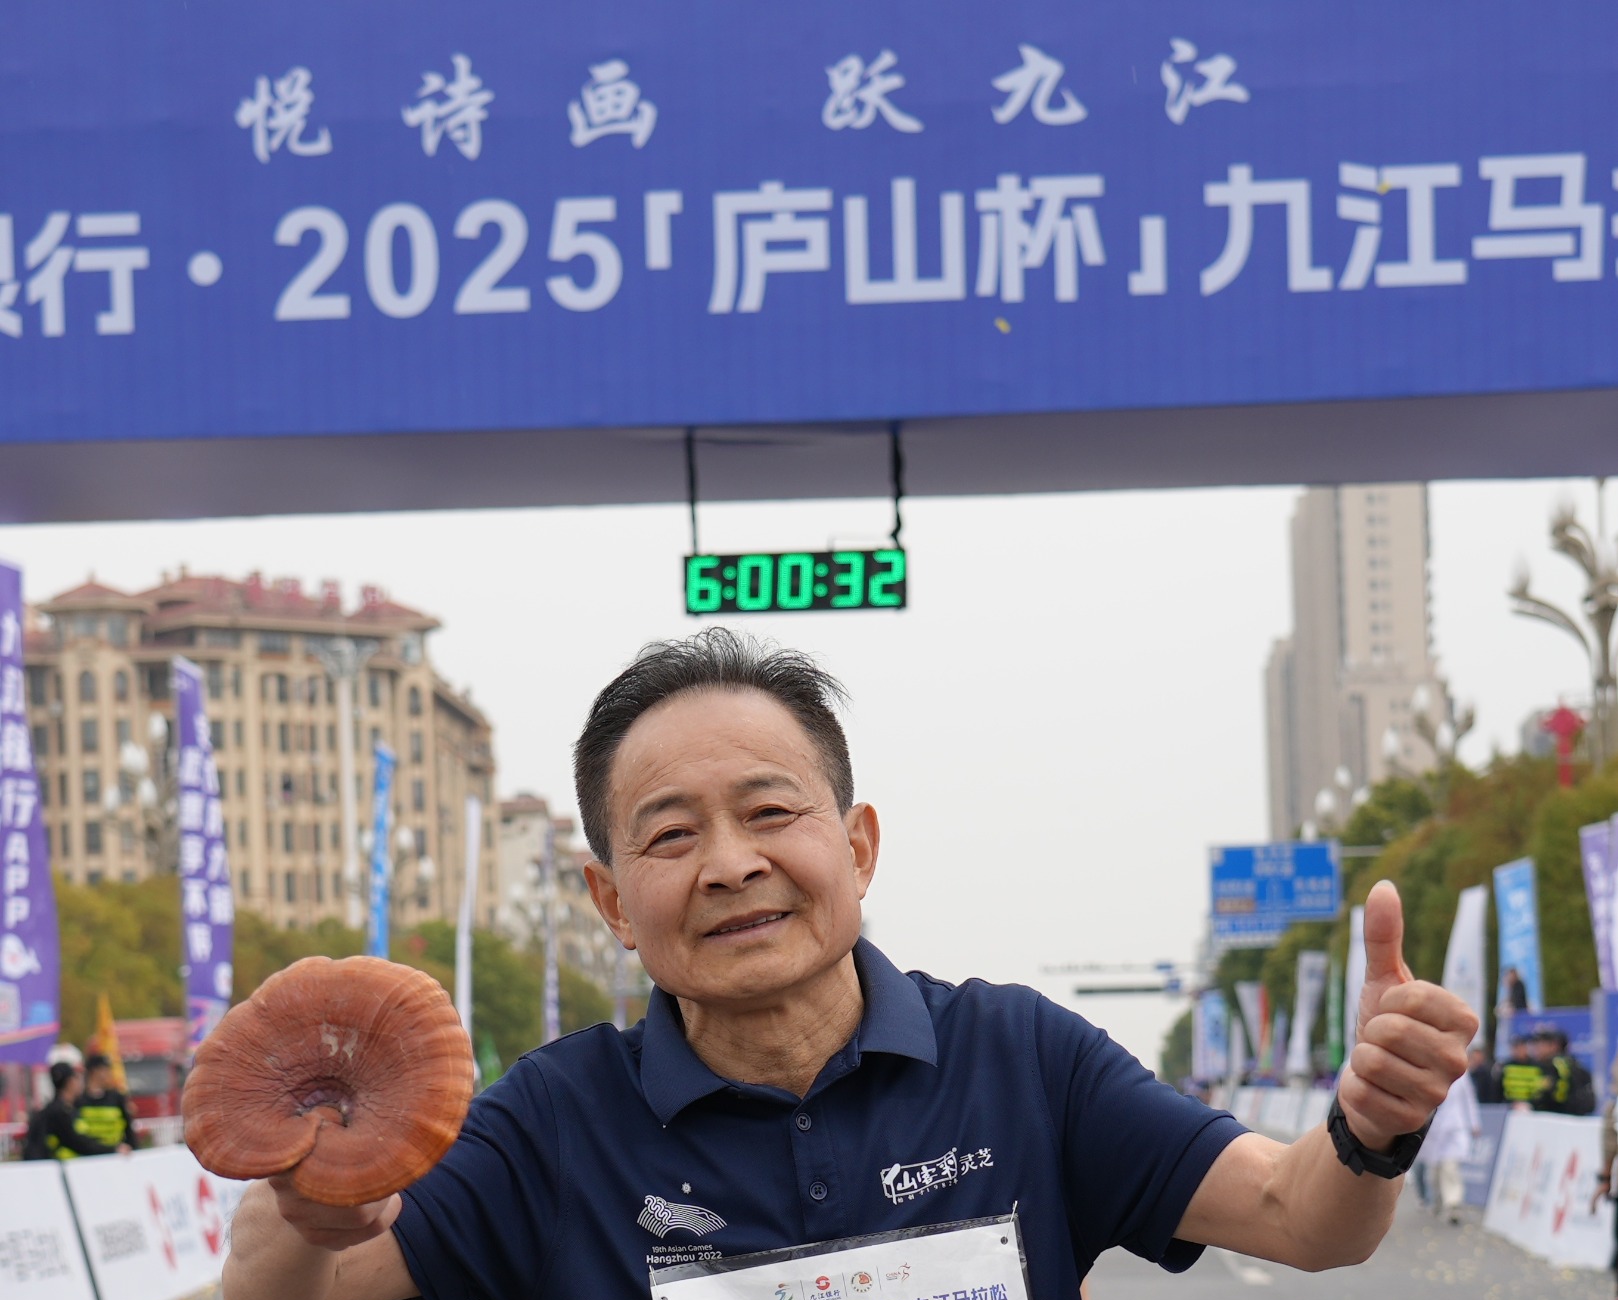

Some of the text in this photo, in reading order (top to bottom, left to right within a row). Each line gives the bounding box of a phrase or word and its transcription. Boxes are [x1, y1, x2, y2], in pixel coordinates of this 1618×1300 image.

[235, 37, 1251, 164] 悦诗画 跃九江
[687, 549, 906, 612] 6:00:32
[646, 1251, 722, 1264] Hangzhou 2022
[667, 1245, 687, 1253] Asian
[687, 1244, 713, 1252] Games
